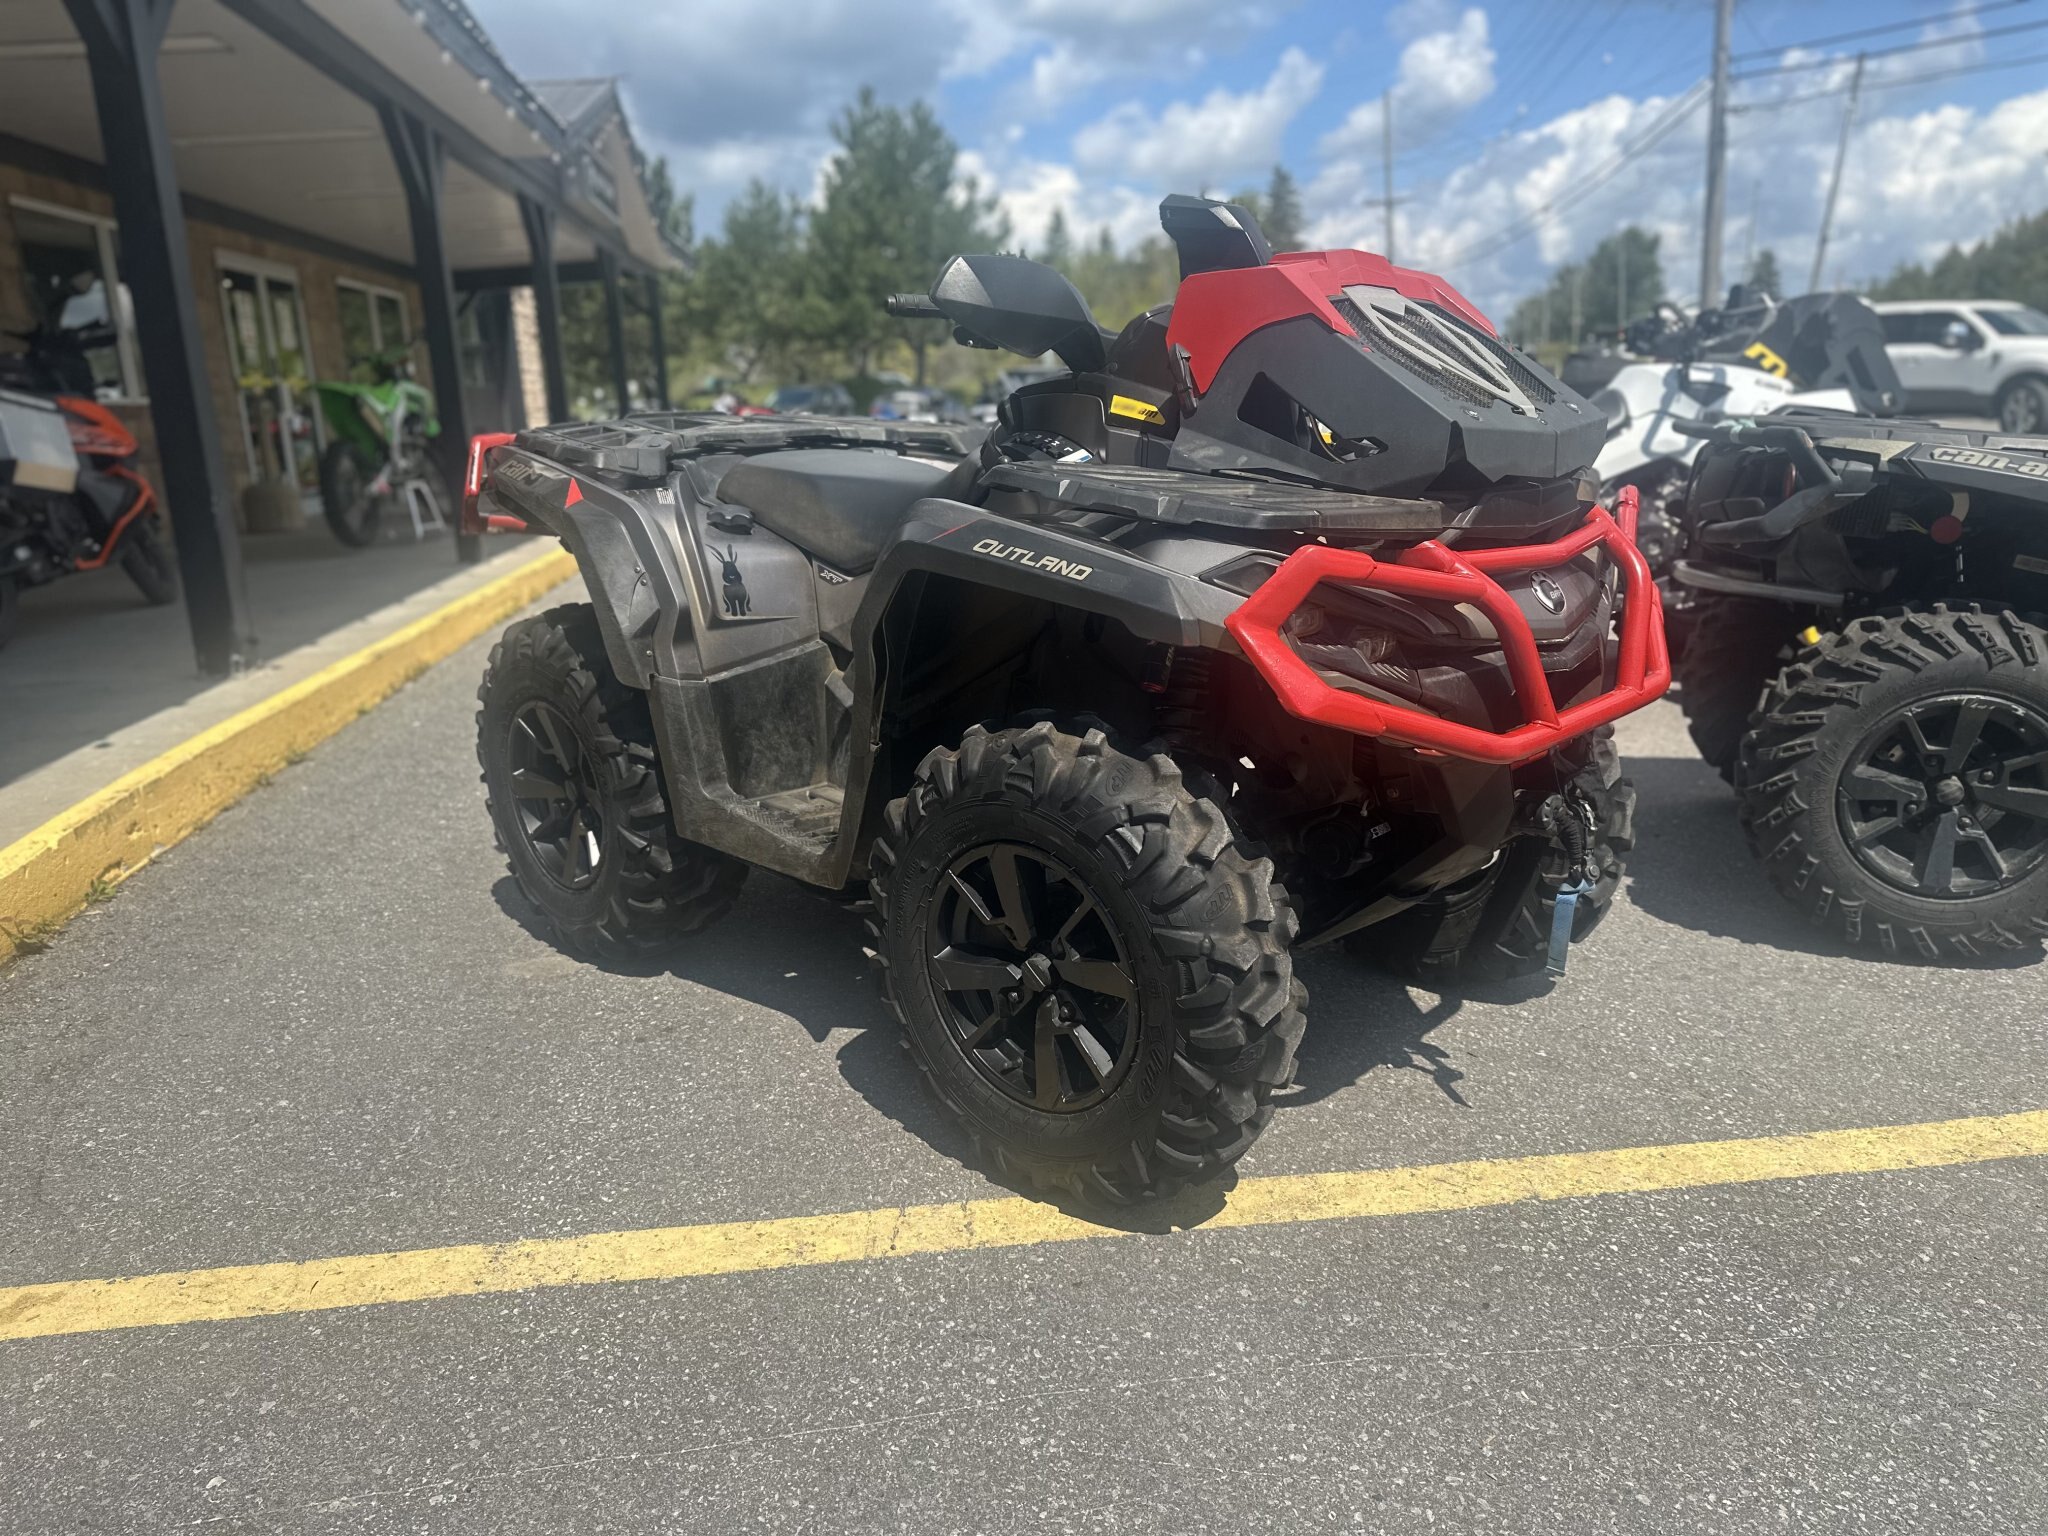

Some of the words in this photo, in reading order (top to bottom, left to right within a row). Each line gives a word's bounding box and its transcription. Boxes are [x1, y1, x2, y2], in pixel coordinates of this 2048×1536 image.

[1931, 447, 2048, 477] can-a
[972, 538, 1093, 581] OUTLAND
[820, 570, 843, 583] XT
